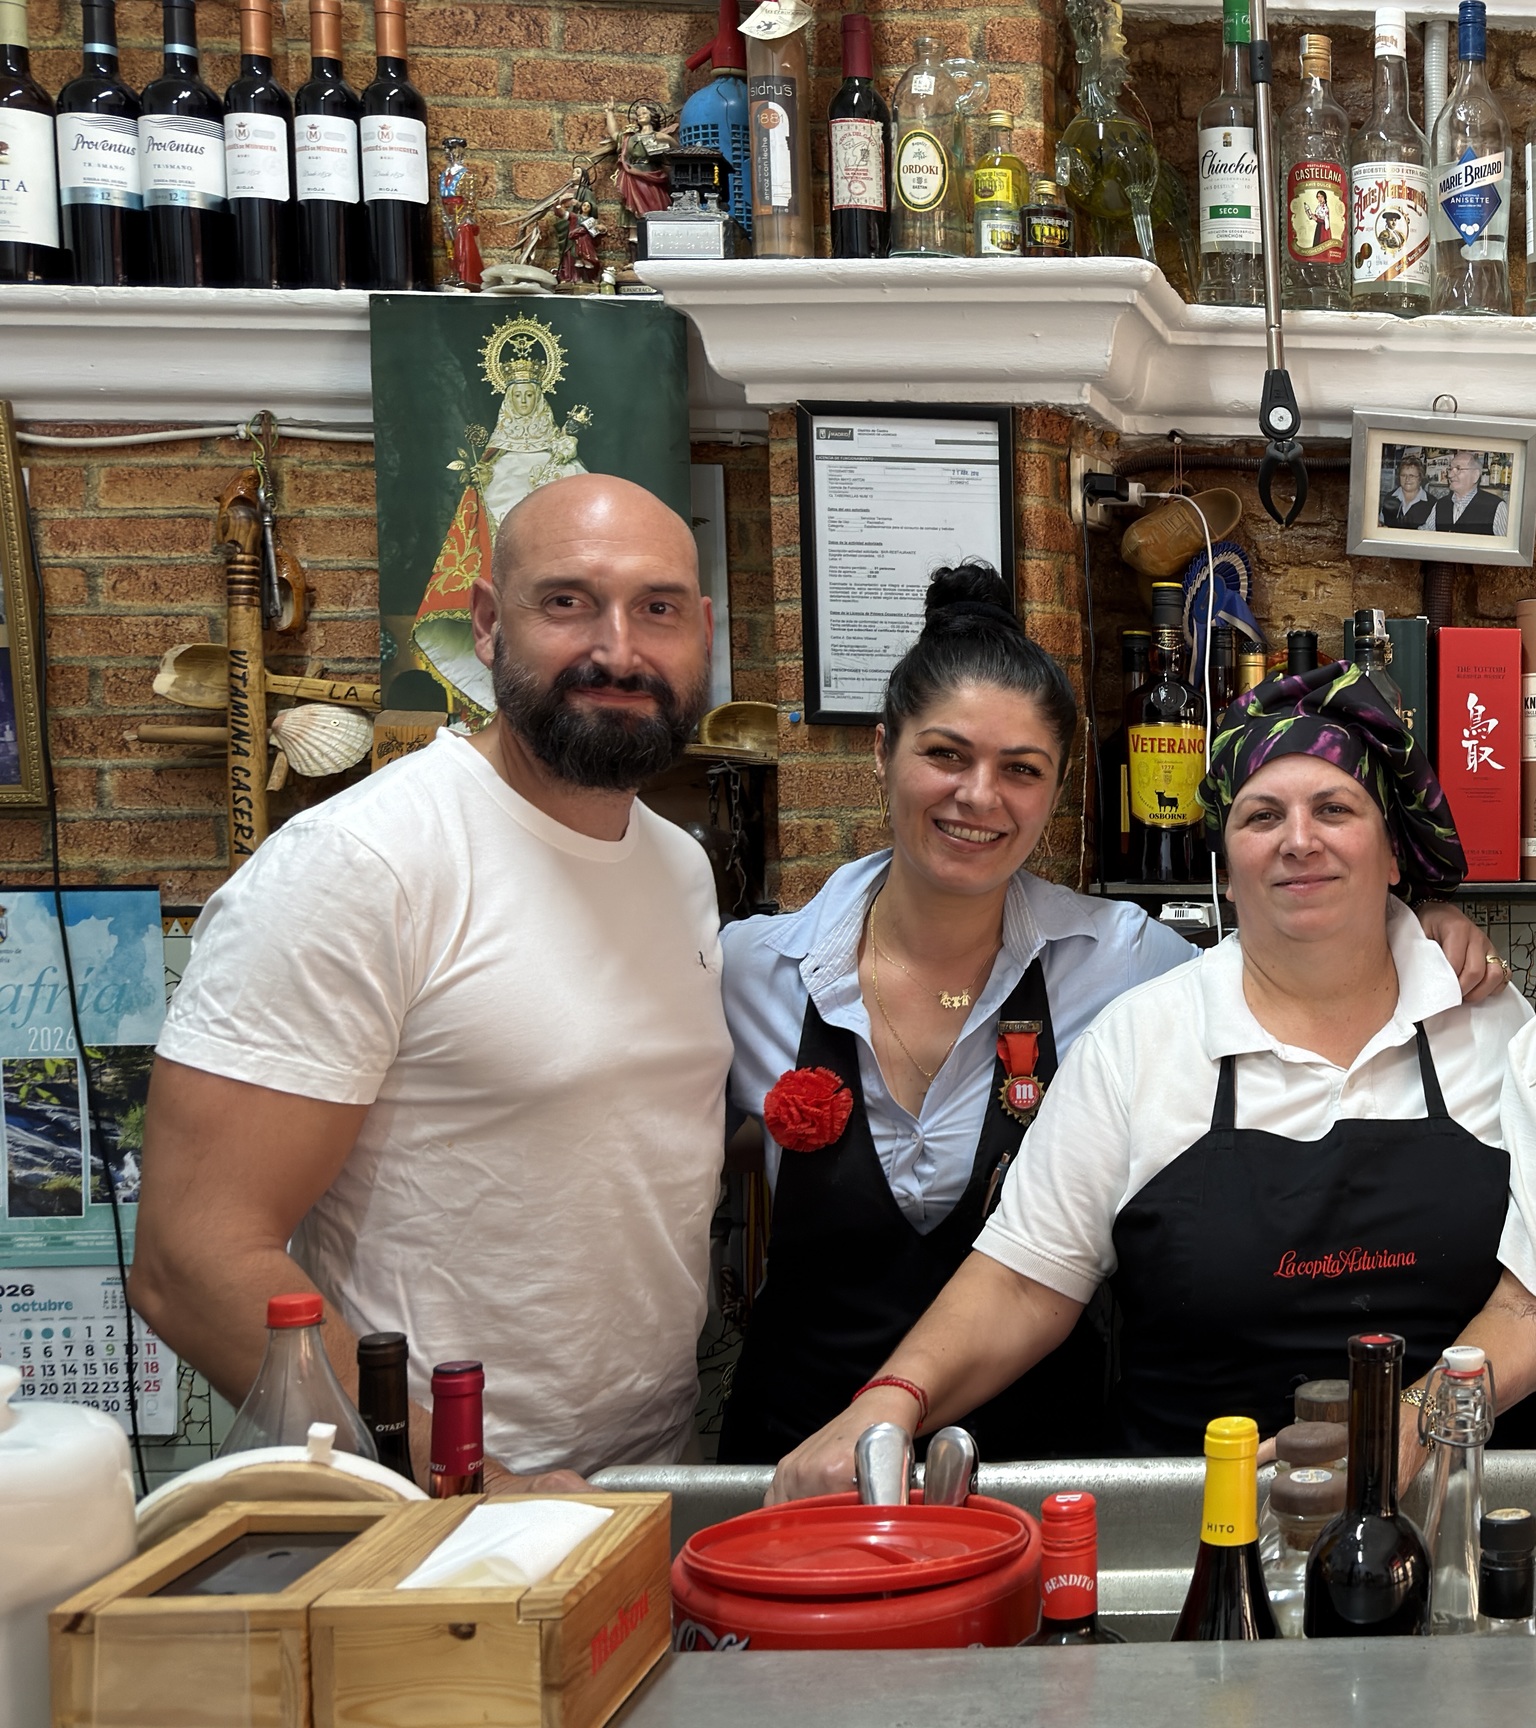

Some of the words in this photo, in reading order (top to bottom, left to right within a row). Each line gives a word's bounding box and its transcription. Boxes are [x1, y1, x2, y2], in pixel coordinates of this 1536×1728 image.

[145, 136, 205, 155] Proventus
[902, 165, 939, 175] ORDOKI
[1294, 170, 1342, 184] CASTELLANA
[1439, 176, 1463, 194] MARIE
[1464, 160, 1502, 188] BRIZARD
[101, 192, 110, 201] 12
[169, 192, 178, 201] 12
[328, 683, 358, 699] LA
[229, 650, 251, 766] VITAMINA
[1462, 693, 1506, 773] 鳥取
[1132, 734, 1205, 755] VETERANO
[230, 766, 254, 856] CASERA
[1149, 812, 1187, 820] OSBORNE
[28, 1027, 76, 1052] 2026
[1338, 1246, 1418, 1278] Asturiana
[11, 1299, 74, 1313] octubre
[86, 1326, 91, 1338] 1
[105, 1325, 114, 1337] 2
[22, 1346, 31, 1358] 5
[43, 1346, 53, 1358] 6
[64, 1345, 74, 1357] 7
[85, 1345, 95, 1357] 8
[105, 1344, 115, 1356] 9
[145, 1343, 157, 1355] 11
[20, 1365, 35, 1377] 12
[40, 1365, 56, 1377] 13
[61, 1364, 78, 1376] 14
[82, 1363, 98, 1375] 15
[103, 1363, 119, 1375] 16
[144, 1362, 160, 1374] 18
[21, 1384, 36, 1396] 19
[40, 1383, 59, 1395] 20
[63, 1382, 77, 1394] 21
[82, 1382, 100, 1394] 22
[102, 1381, 119, 1393] 23
[144, 1380, 161, 1392] 25
[101, 1400, 120, 1412] 30
[375, 1420, 406, 1433] OTAZU
[1207, 1522, 1235, 1534] HITO
[1044, 1573, 1095, 1595] BENDITO
